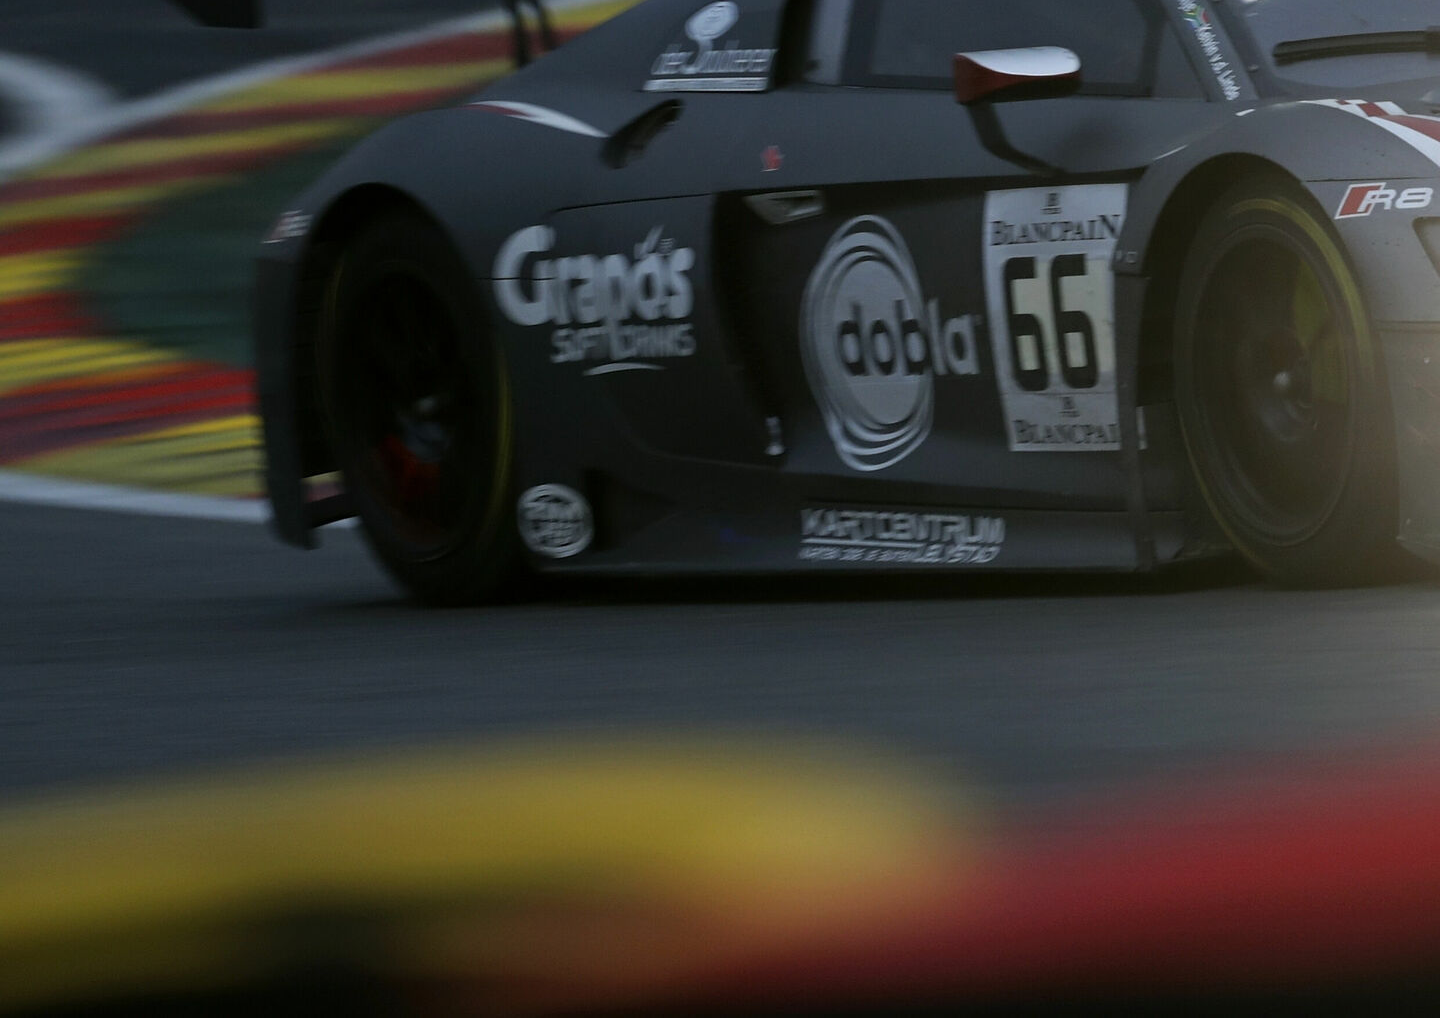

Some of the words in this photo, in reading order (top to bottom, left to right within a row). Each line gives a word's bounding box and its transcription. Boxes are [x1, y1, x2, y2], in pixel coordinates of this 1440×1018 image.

[1357, 187, 1434, 213] R8
[990, 213, 1121, 246] BLANCPAIN
[838, 297, 983, 377] dobla
[1003, 253, 1100, 392] 66
